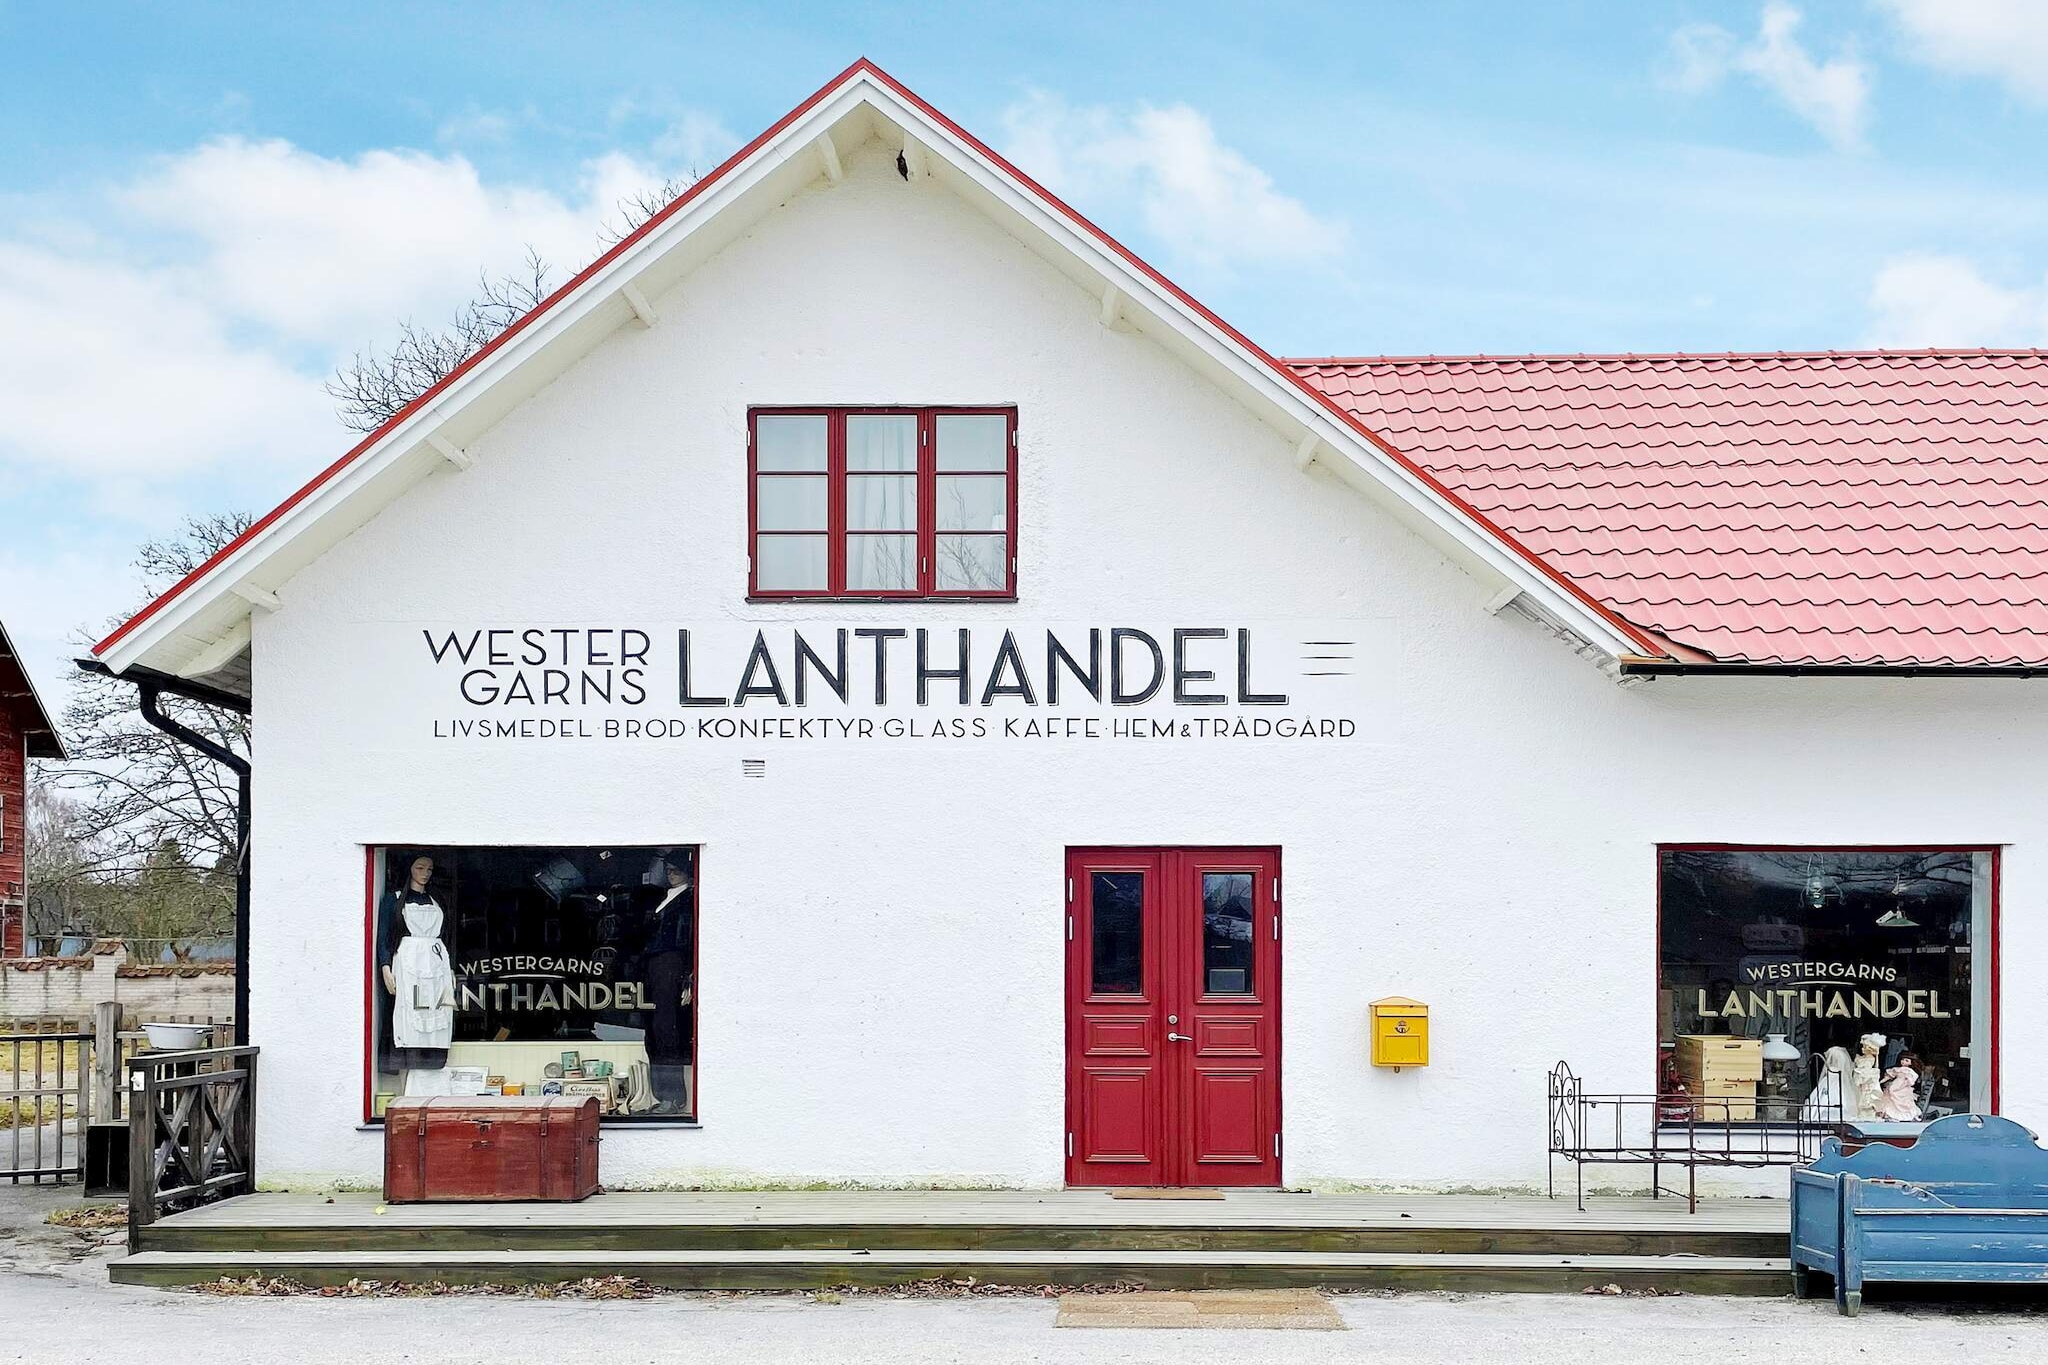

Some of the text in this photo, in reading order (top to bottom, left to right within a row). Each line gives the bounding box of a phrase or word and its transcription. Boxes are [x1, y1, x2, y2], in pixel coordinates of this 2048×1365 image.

[422, 628, 652, 667] WESTER
[678, 627, 1291, 709] LANTHANDEL
[460, 668, 648, 706] GARNS
[434, 718, 593, 739] LIVSMEDEL
[698, 717, 874, 739] KONFEKTYR
[883, 717, 986, 739] GLASS
[1004, 717, 1100, 739] KAFFE
[458, 955, 604, 977] WESTERGARNS
[1746, 962, 1897, 982] WESTERGARNS
[1698, 988, 1951, 1019] LANTHANDEL
